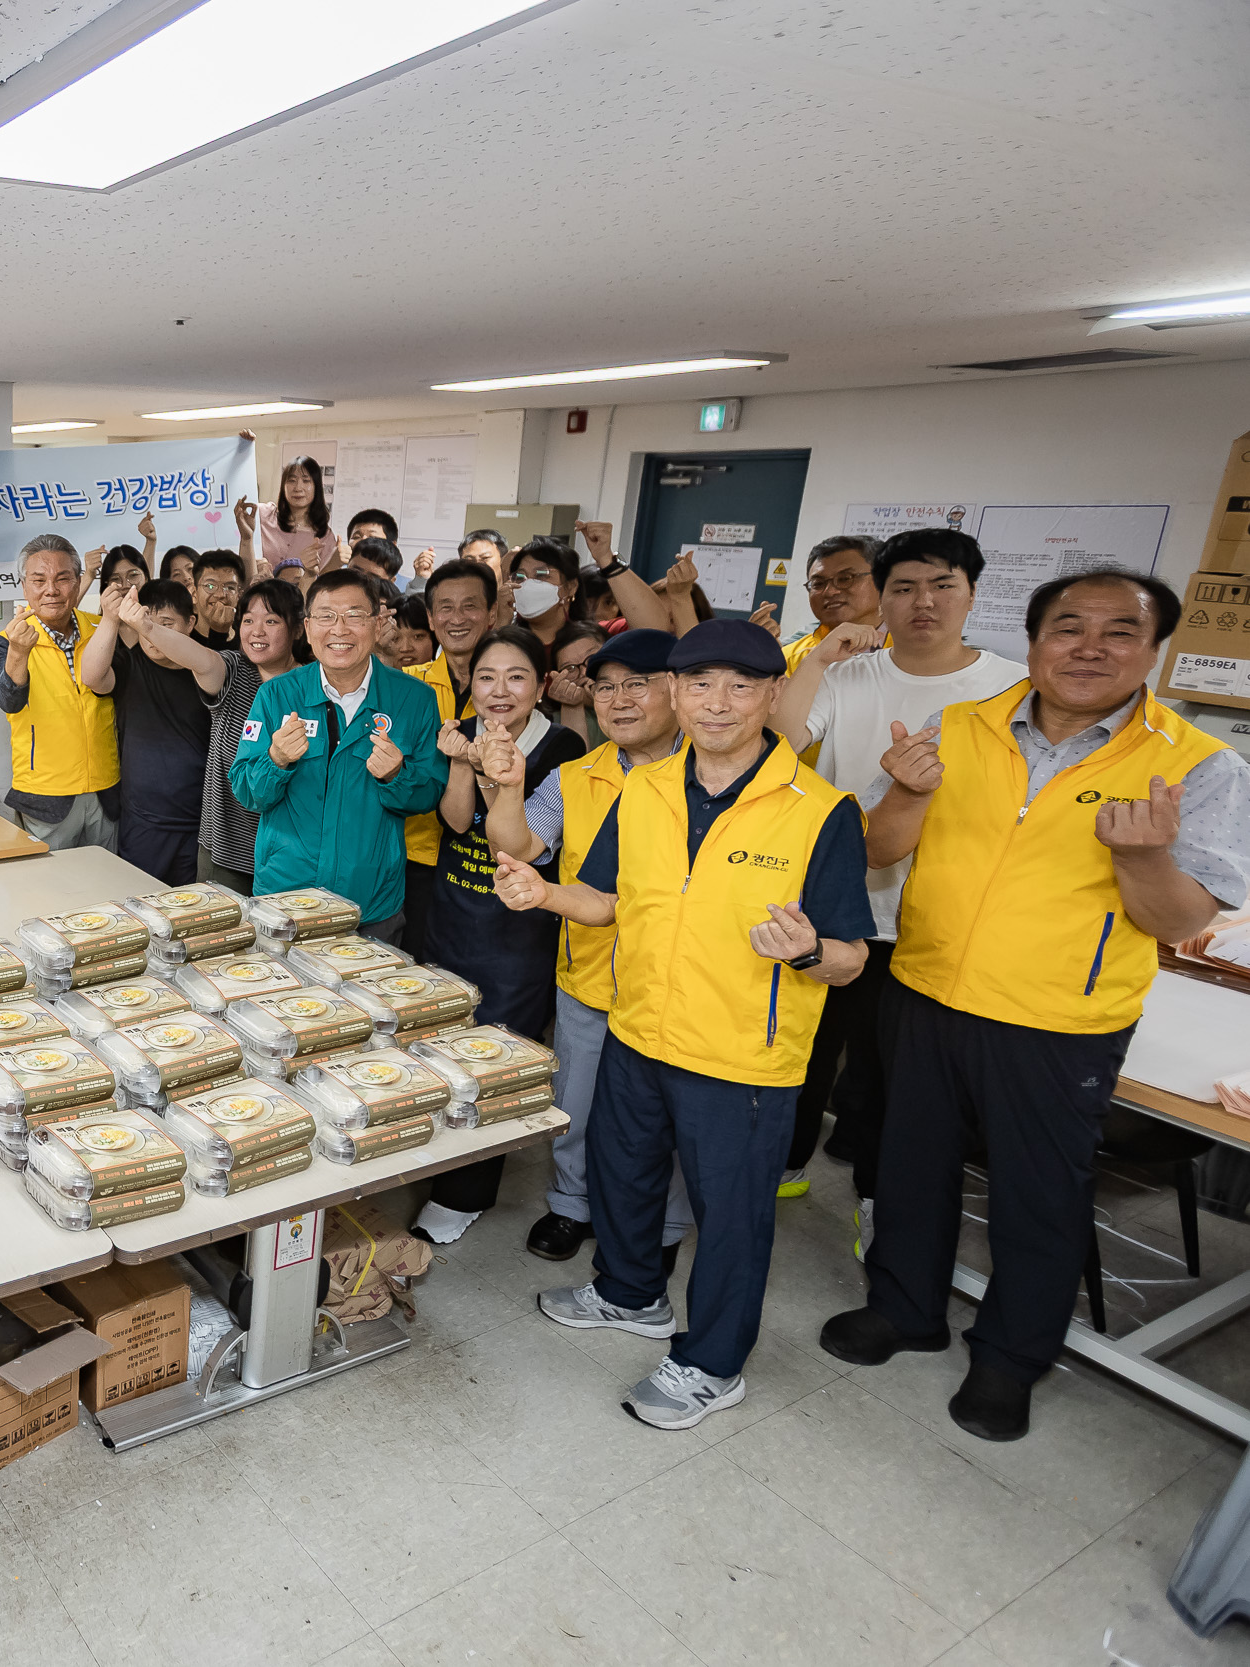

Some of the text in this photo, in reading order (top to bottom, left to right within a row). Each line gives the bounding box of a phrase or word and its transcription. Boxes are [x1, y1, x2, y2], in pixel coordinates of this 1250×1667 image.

[94, 466, 230, 518] 건강밥상」
[1180, 656, 1237, 670] S-6859EA
[752, 853, 790, 867] 광진구
